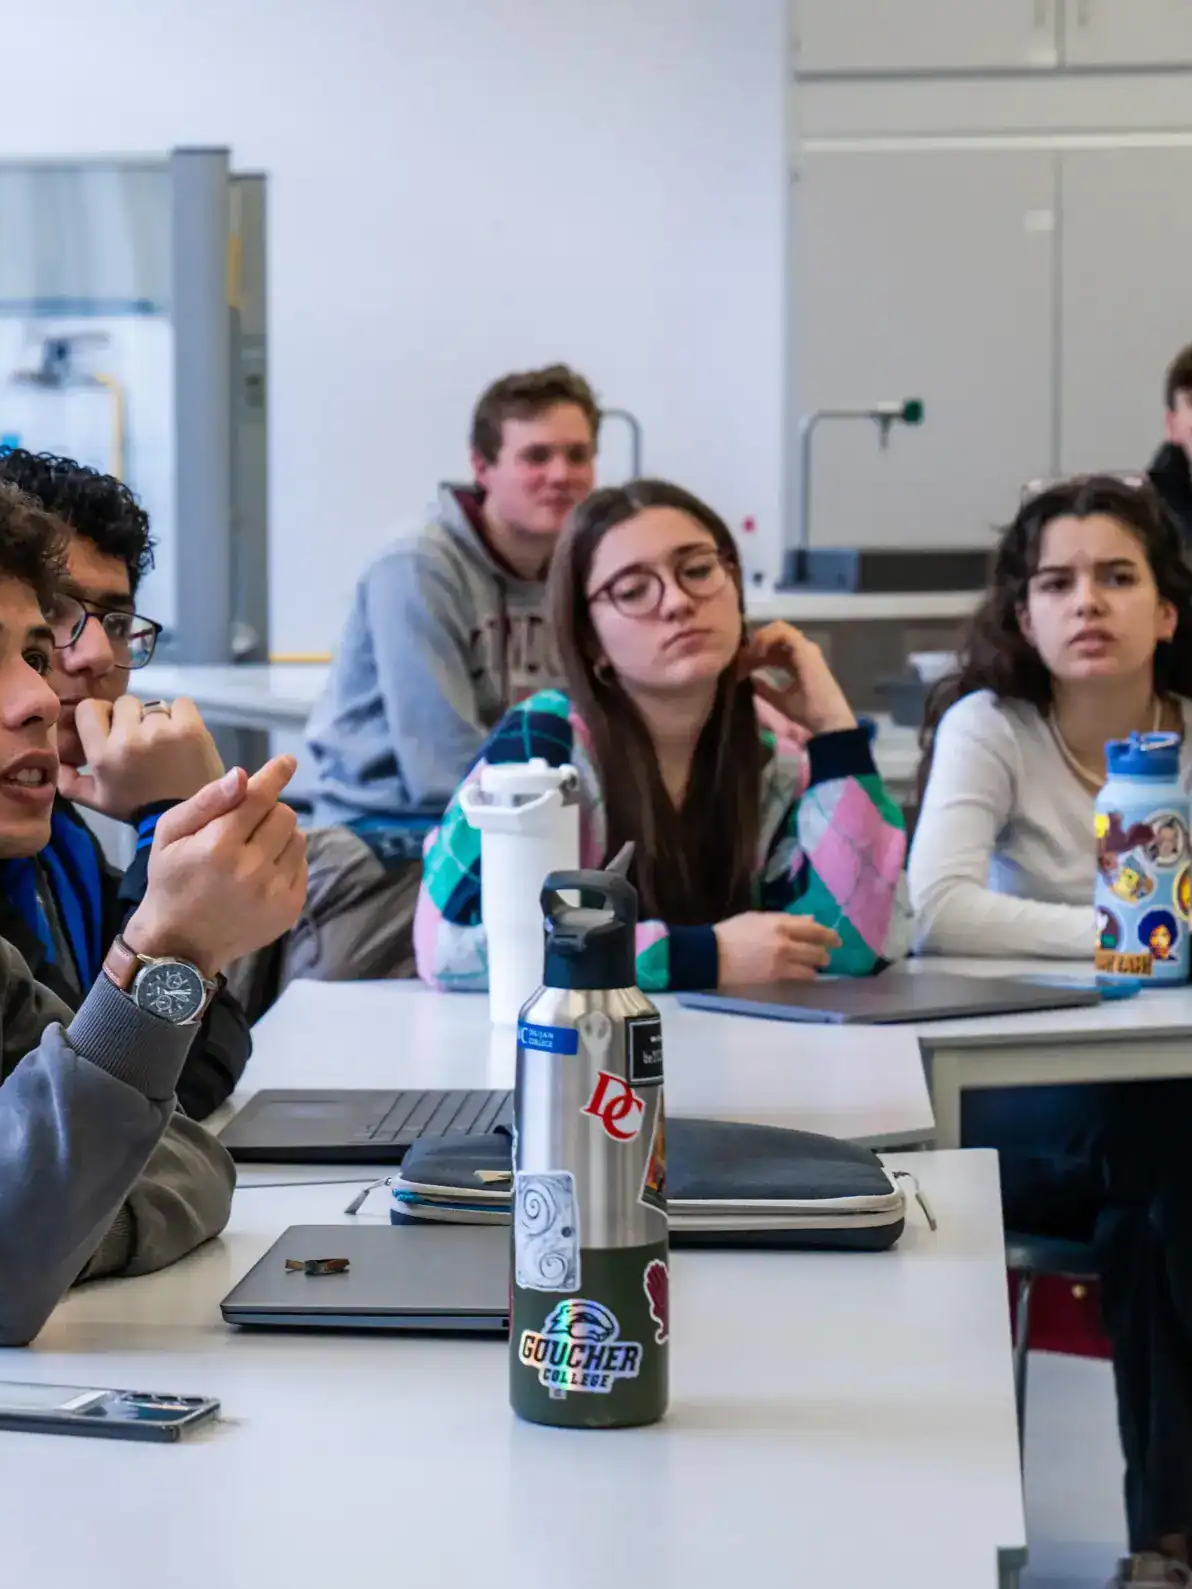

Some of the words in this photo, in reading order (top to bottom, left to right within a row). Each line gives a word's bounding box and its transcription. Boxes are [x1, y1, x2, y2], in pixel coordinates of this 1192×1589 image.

[584, 1072, 643, 1139] DC
[522, 1335, 639, 1371] GOUCHER
[543, 1368, 609, 1388] COLLEGE
